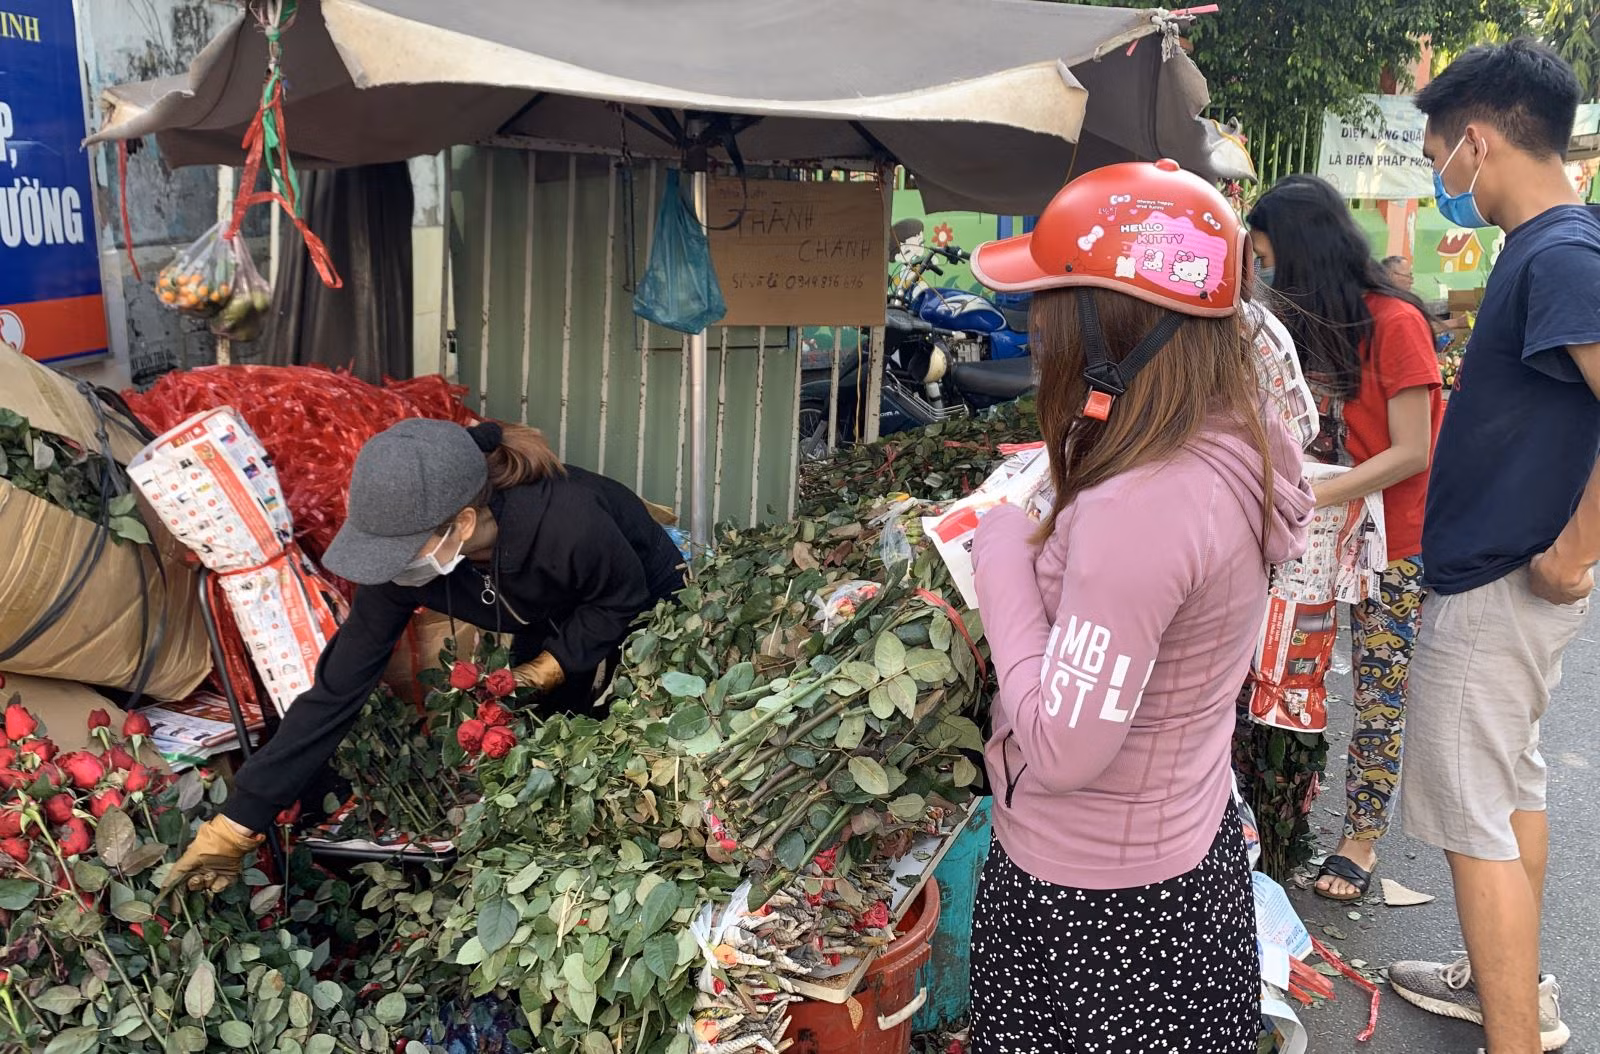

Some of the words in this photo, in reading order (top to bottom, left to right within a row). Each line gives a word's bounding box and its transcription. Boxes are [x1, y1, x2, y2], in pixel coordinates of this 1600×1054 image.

[1329, 151, 1342, 165] LÀ
[1346, 152, 1373, 168] BIỆN
[1120, 223, 1163, 233] HELLO
[1137, 233, 1184, 245] KITTY
